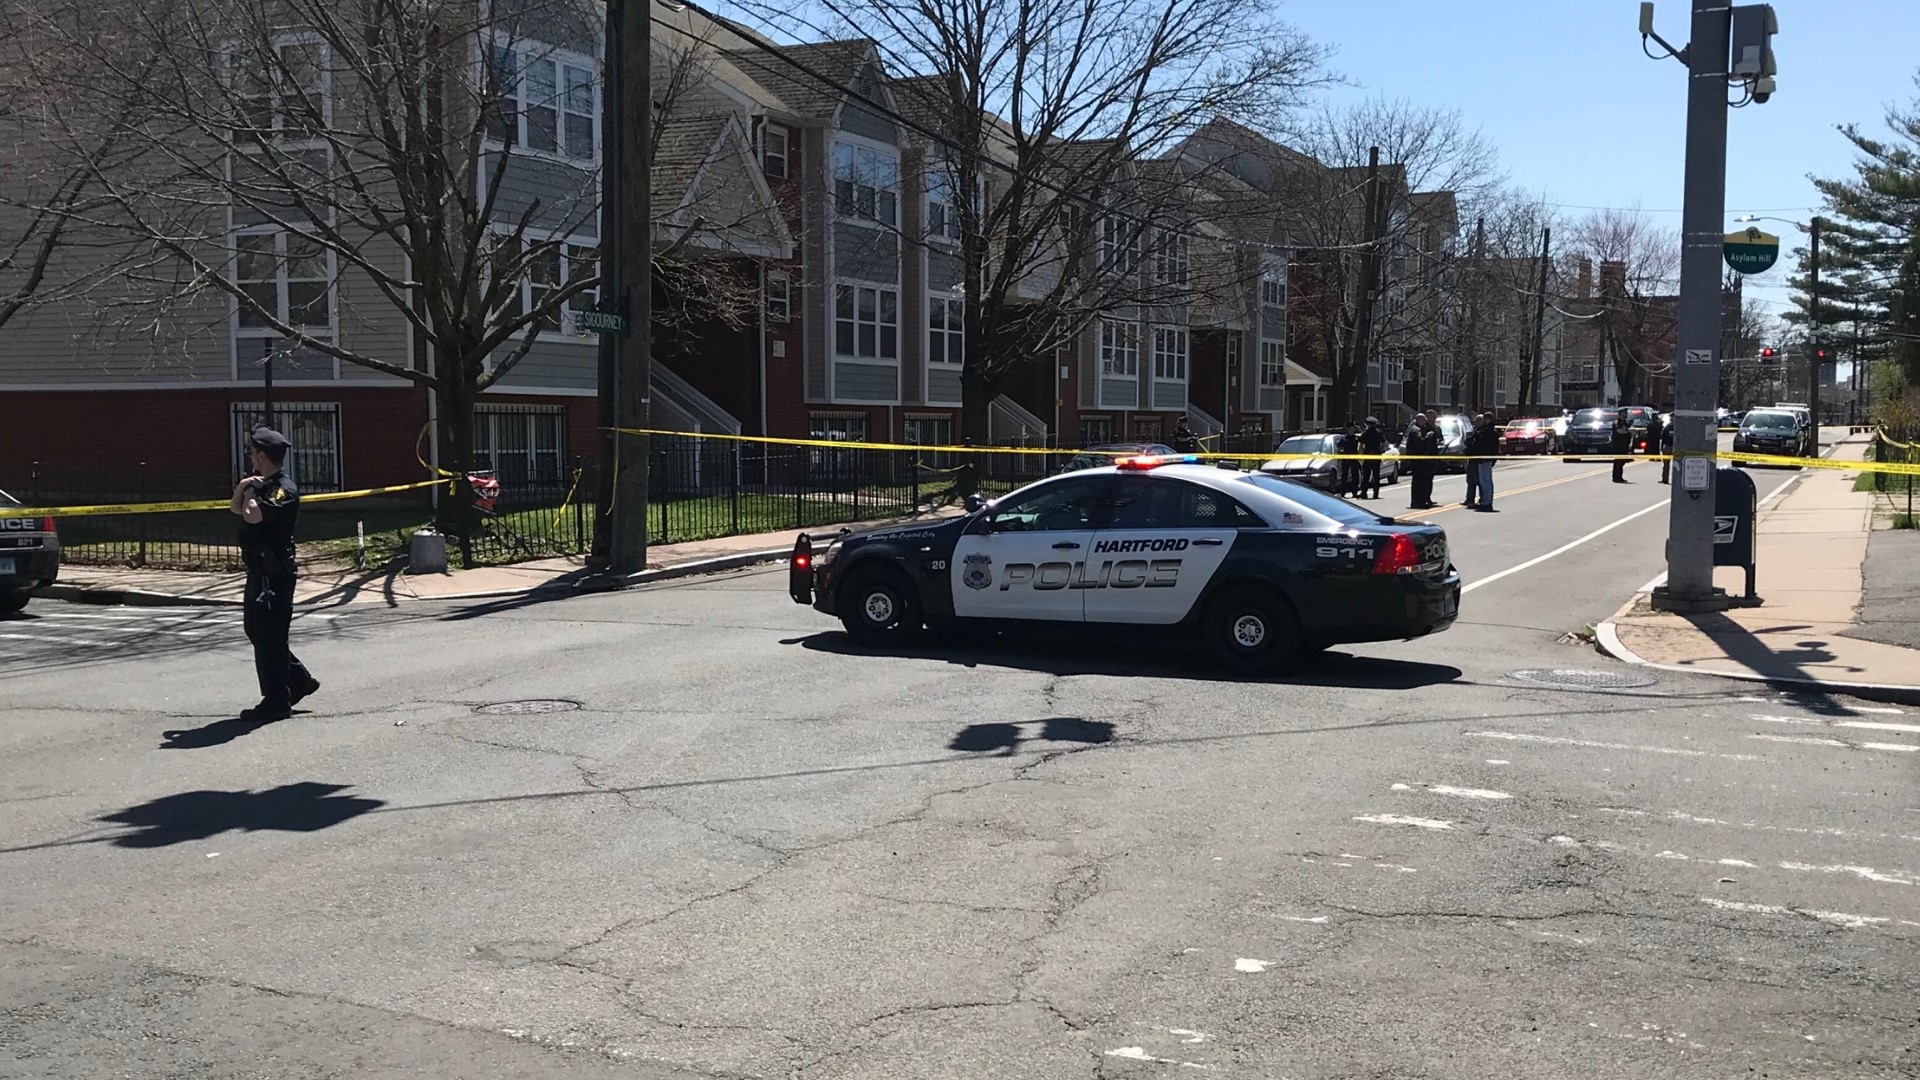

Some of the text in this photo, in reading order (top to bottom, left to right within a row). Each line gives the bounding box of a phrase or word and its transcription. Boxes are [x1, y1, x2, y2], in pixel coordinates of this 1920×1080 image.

[1730, 253, 1772, 264] Asylum Hill
[584, 312, 622, 330] SIGOURNEY
[1094, 538, 1190, 553] HARTFORD
[1316, 537, 1374, 546] EMERGENCY
[1316, 547, 1374, 559] 911
[931, 560, 946, 570] 20
[1000, 558, 1183, 592] POLICE
